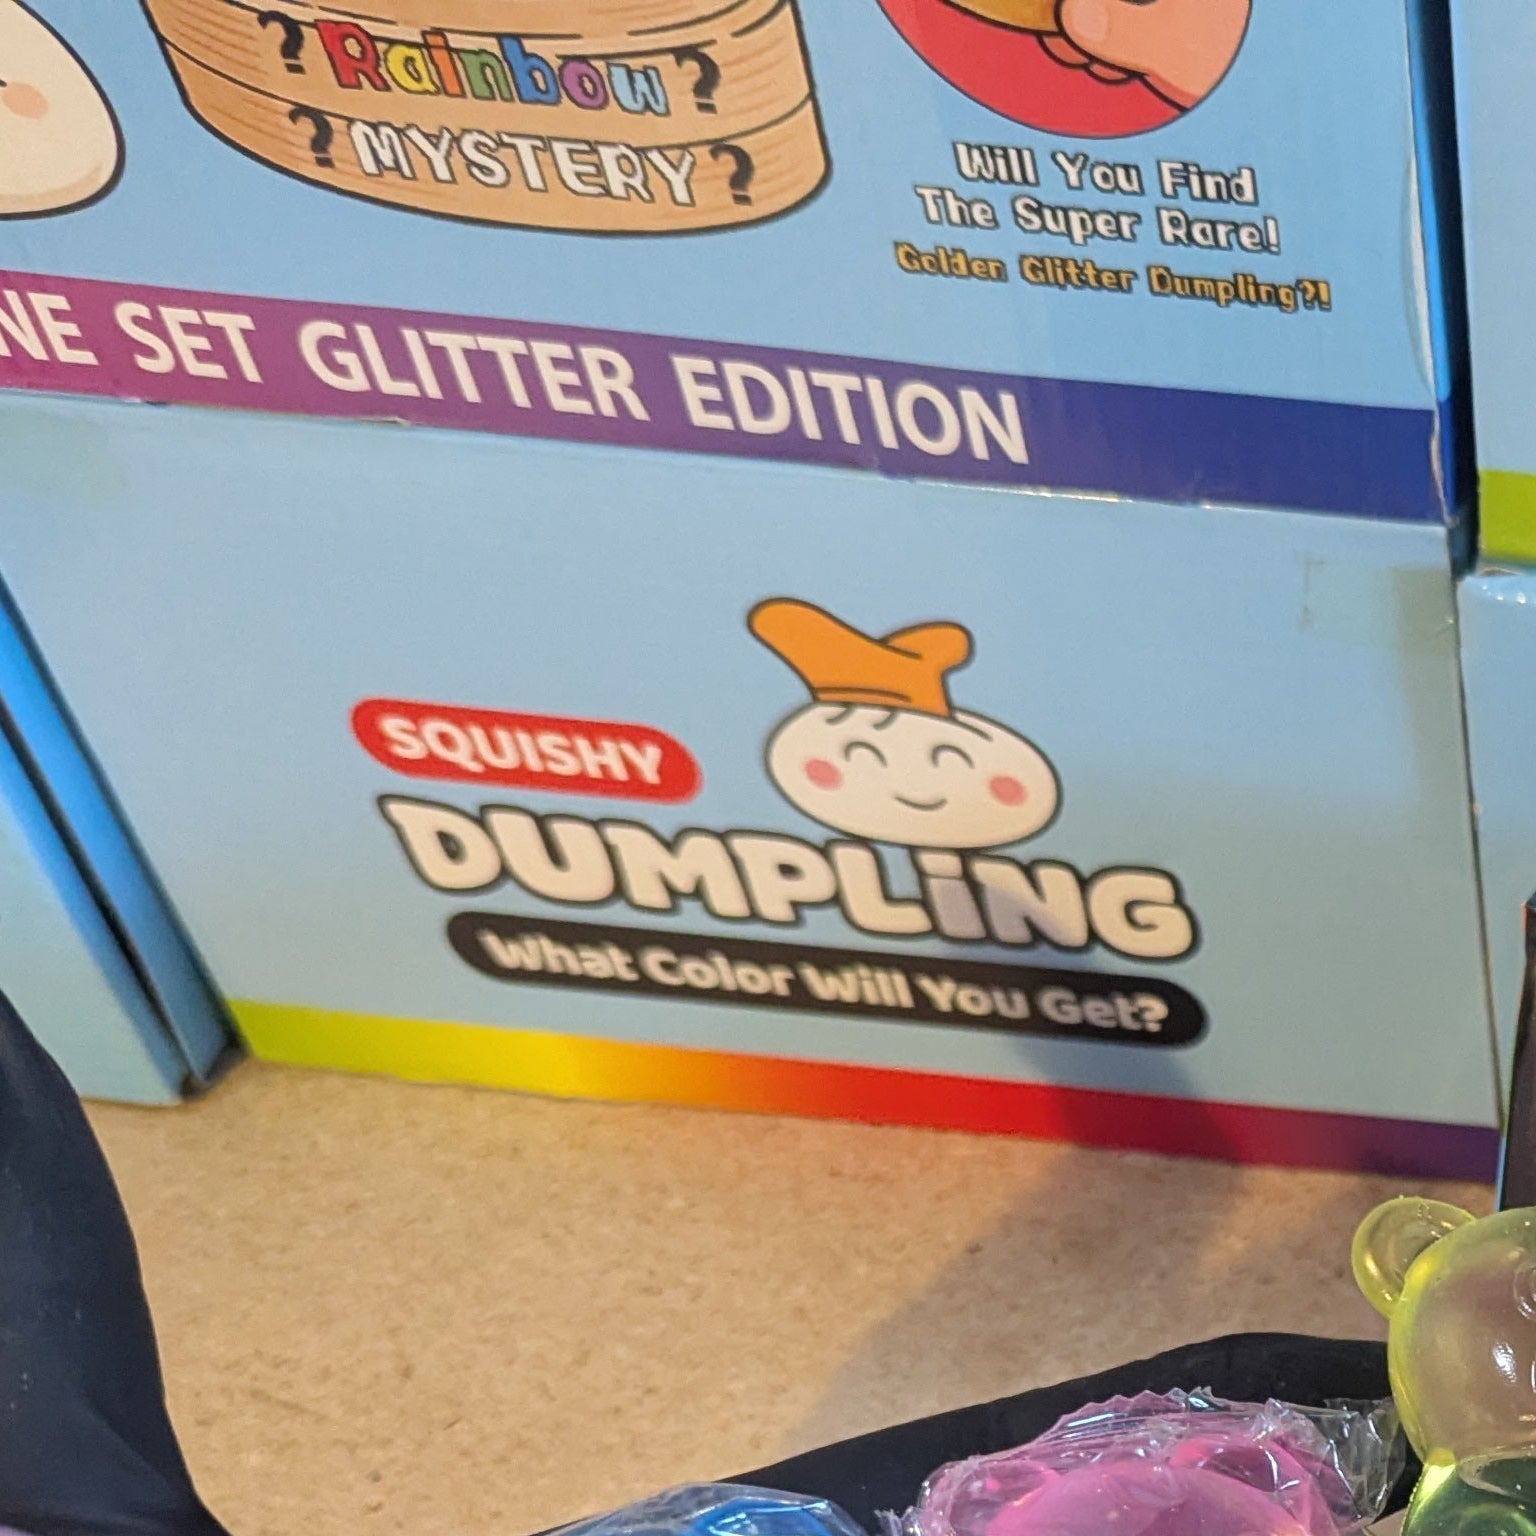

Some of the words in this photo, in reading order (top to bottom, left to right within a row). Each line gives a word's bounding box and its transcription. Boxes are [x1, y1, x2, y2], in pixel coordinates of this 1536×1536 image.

[314, 19, 671, 116] Rainbow
[348, 120, 696, 206] MYSTERY
[953, 142, 1040, 186] Will
[1052, 151, 1143, 195] You
[1156, 159, 1259, 205] Find
[915, 185, 997, 229] The
[1012, 194, 1141, 246] Super
[1156, 206, 1281, 255] Rare!
[893, 242, 1008, 281] Golden
[1018, 253, 1137, 294] Glitter
[1147, 265, 1333, 313] Dumpling?!
[0, 290, 99, 366] NE
[114, 301, 264, 383] SET
[299, 320, 651, 422] GLITTER
[669, 356, 1029, 465] EDITION
[380, 715, 665, 786] SQUISHY
[480, 930, 638, 980] What
[641, 945, 794, 1000] Color
[801, 962, 914, 1010] Will
[927, 974, 1031, 1022] You
[1040, 990, 1169, 1035] Get?
